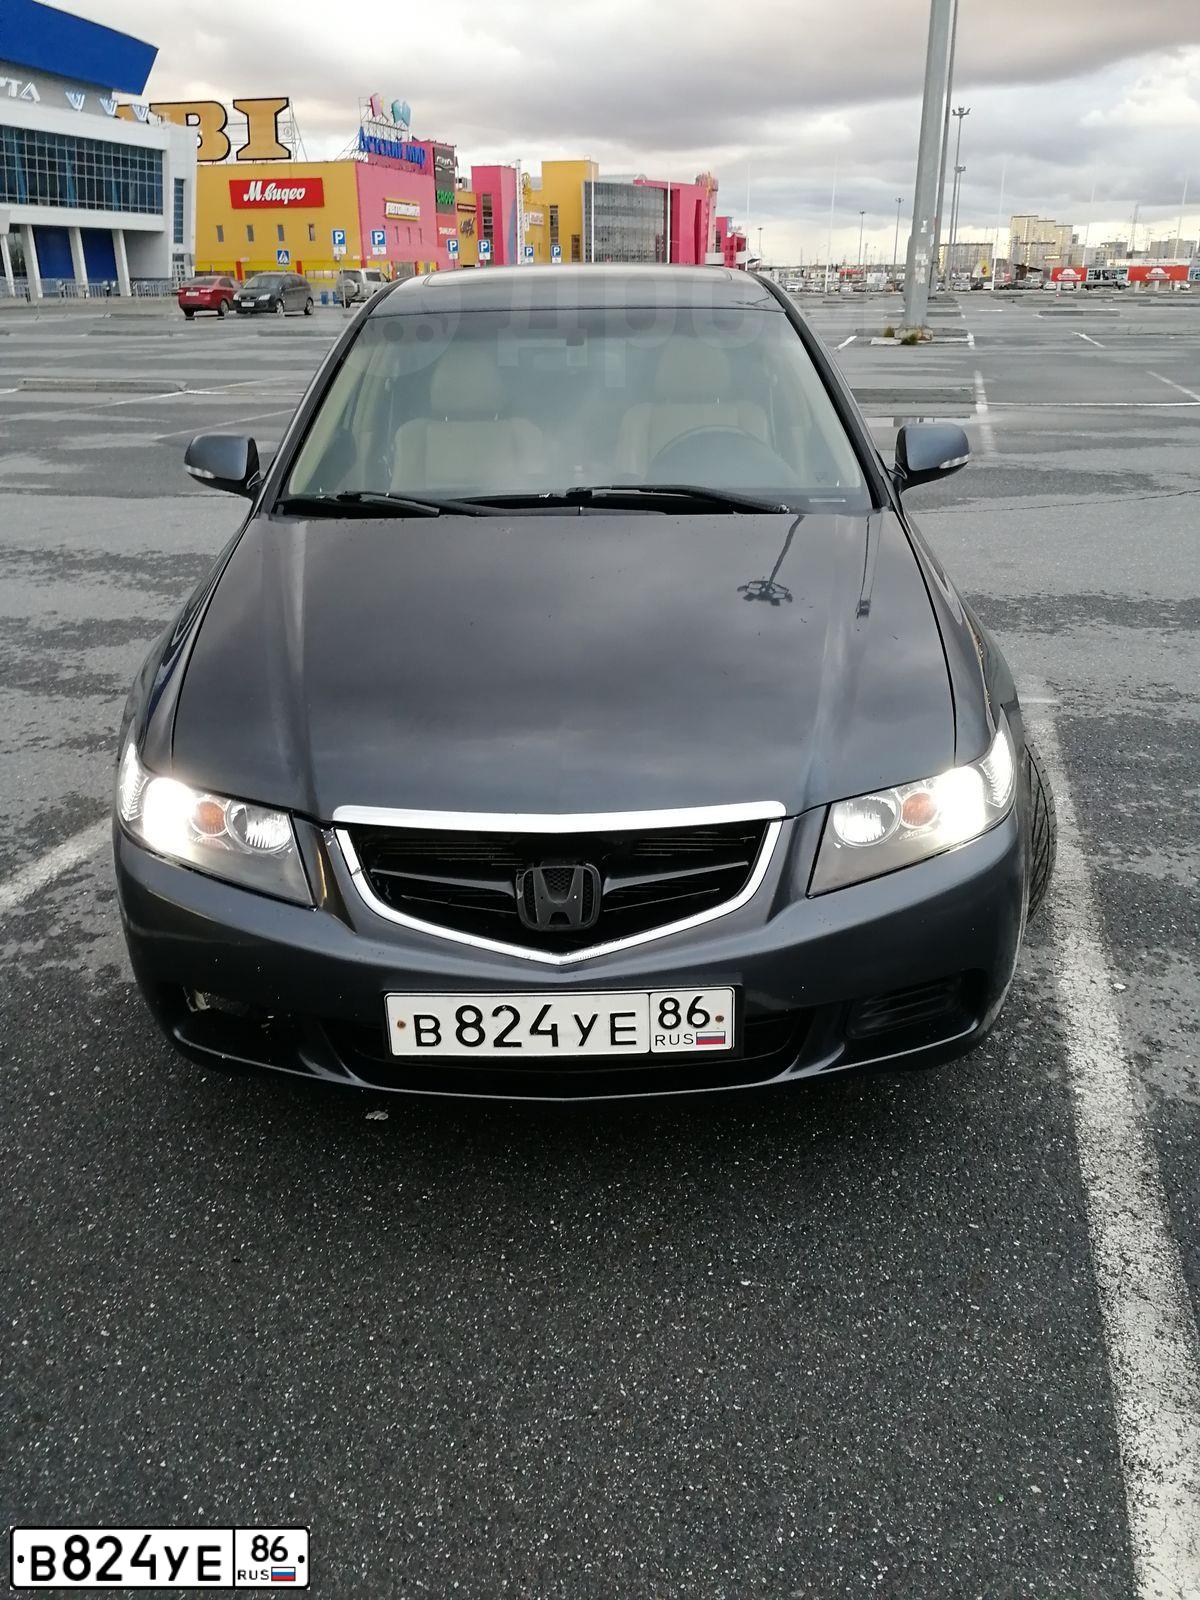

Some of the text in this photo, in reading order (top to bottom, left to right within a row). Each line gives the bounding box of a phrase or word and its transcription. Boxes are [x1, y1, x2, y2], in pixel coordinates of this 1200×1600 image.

[117, 97, 291, 162] BI
[658, 995, 711, 1030] 86
[654, 1032, 694, 1046] RUS
